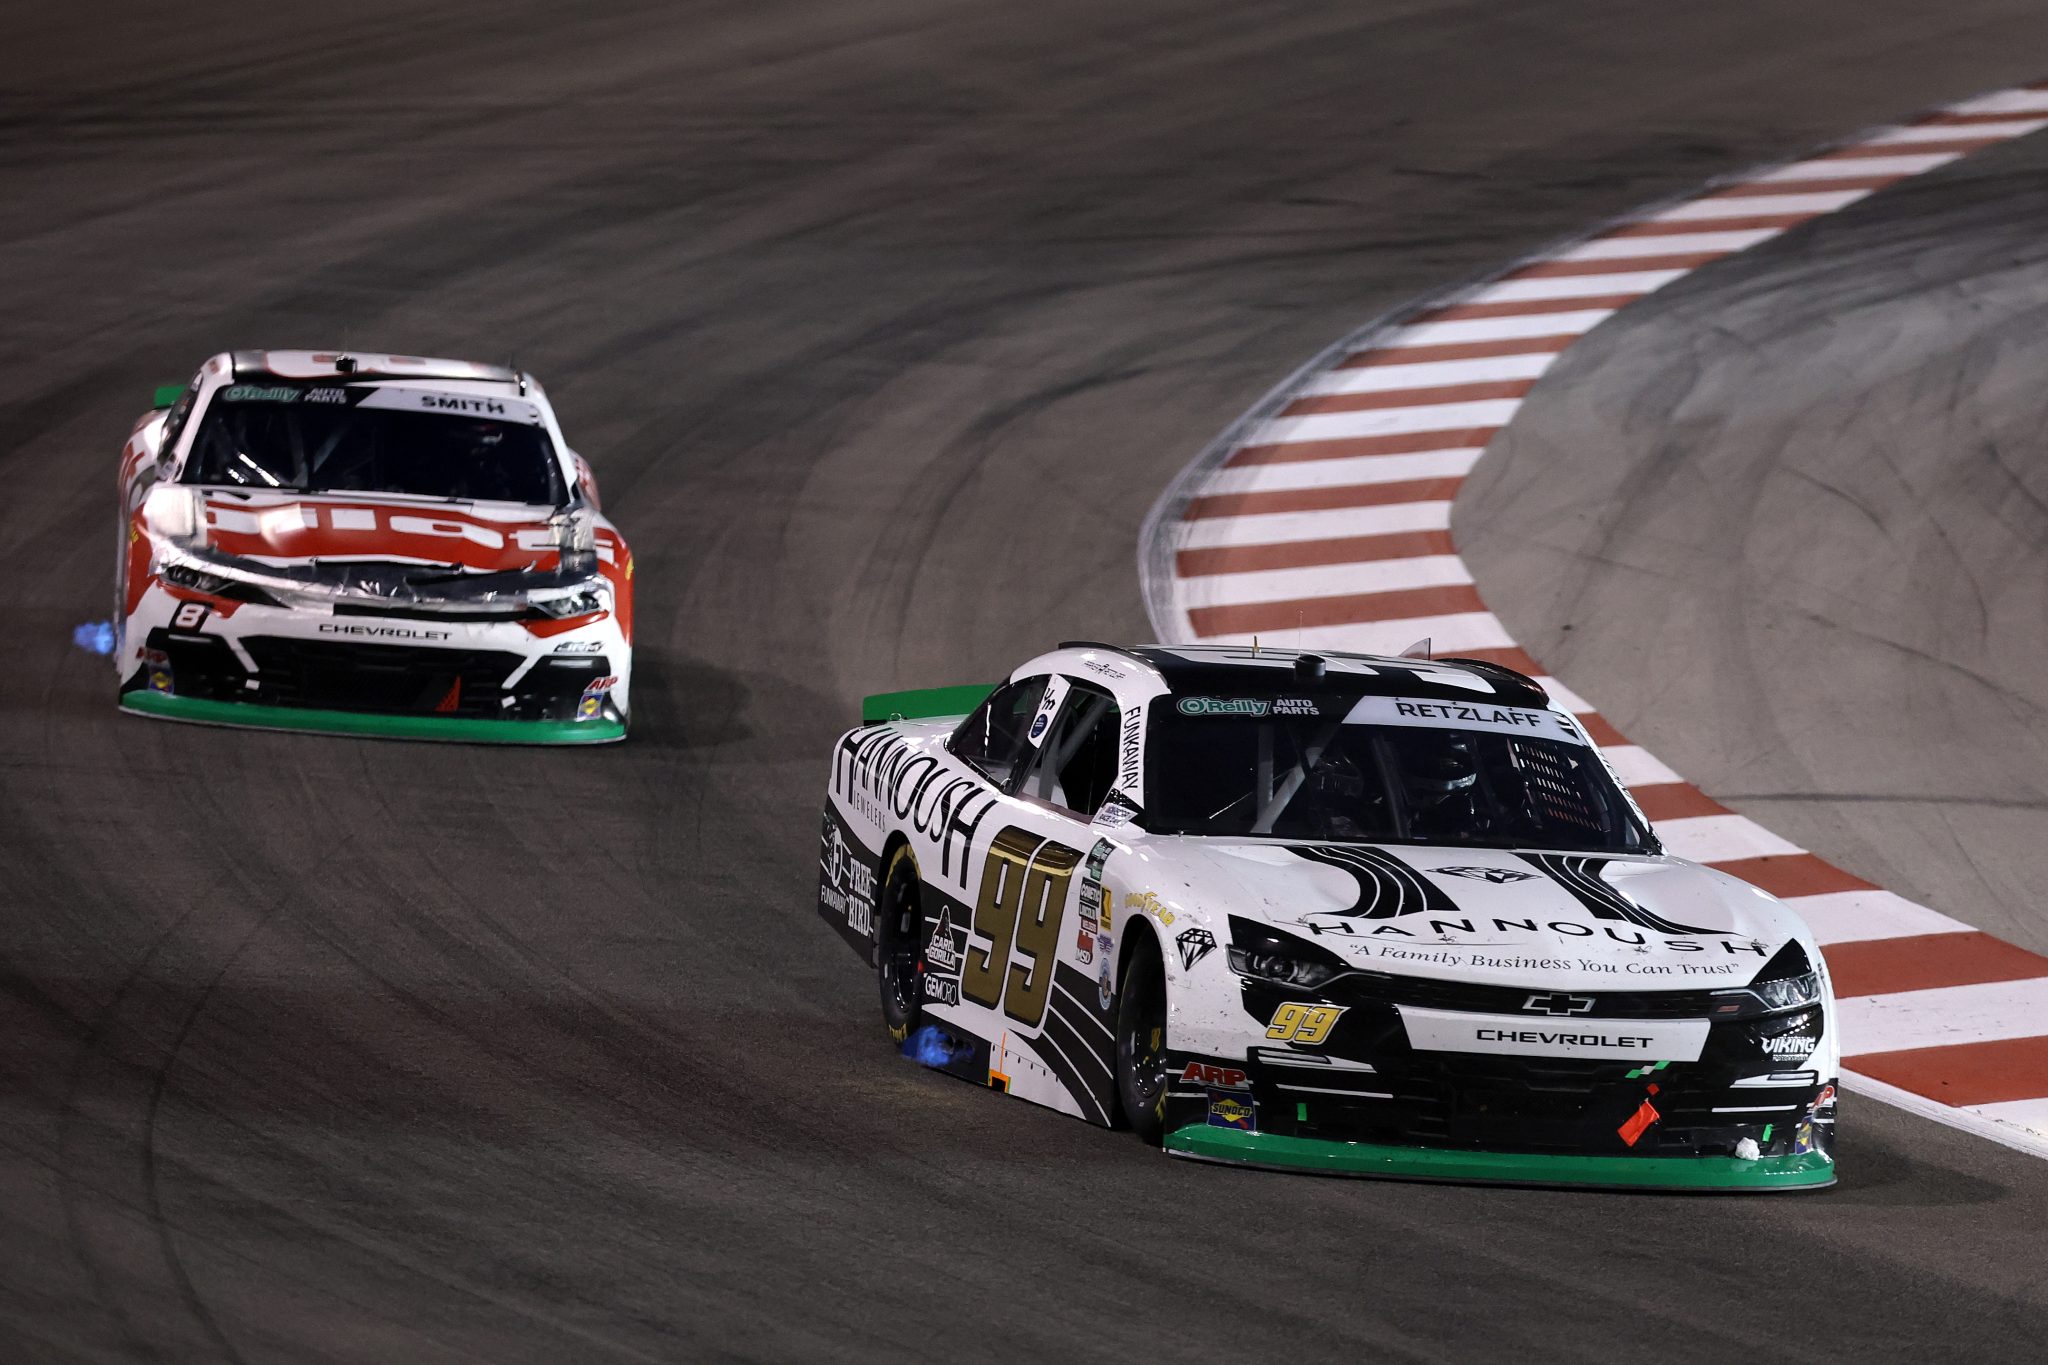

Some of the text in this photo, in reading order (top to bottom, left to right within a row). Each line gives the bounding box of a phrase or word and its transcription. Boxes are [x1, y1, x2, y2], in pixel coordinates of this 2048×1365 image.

[421, 395, 505, 414] SMITH
[175, 603, 206, 628] 8
[319, 624, 453, 640] CHEVROLET
[1180, 698, 1270, 716] O'Reilly
[1273, 706, 1320, 715] PARTS
[1276, 698, 1313, 707] AUTO
[1395, 702, 1541, 727] RETZLAFF
[1122, 706, 1141, 791] FUNKAWAY
[836, 727, 999, 889] HANNOUSH
[853, 788, 886, 833] JEWELERS
[849, 856, 872, 899] FREE
[848, 893, 870, 937] BIRD
[961, 825, 1085, 1029] 99
[933, 935, 954, 953] CARD
[1308, 918, 1767, 957] HANNOUSH
[929, 947, 956, 967] GORILLA
[1381, 947, 1462, 966] Family
[1470, 955, 1572, 970] Business
[1578, 958, 1617, 974] You
[1626, 962, 1672, 975] Can
[925, 975, 957, 1005] GEMORO
[1265, 1003, 1343, 1044] 99
[1477, 1029, 1654, 1048] CHEVROLET
[1760, 1036, 1816, 1054] VIKING
[1182, 1062, 1247, 1085] ARP
[1211, 1103, 1251, 1116] SUNOCO
